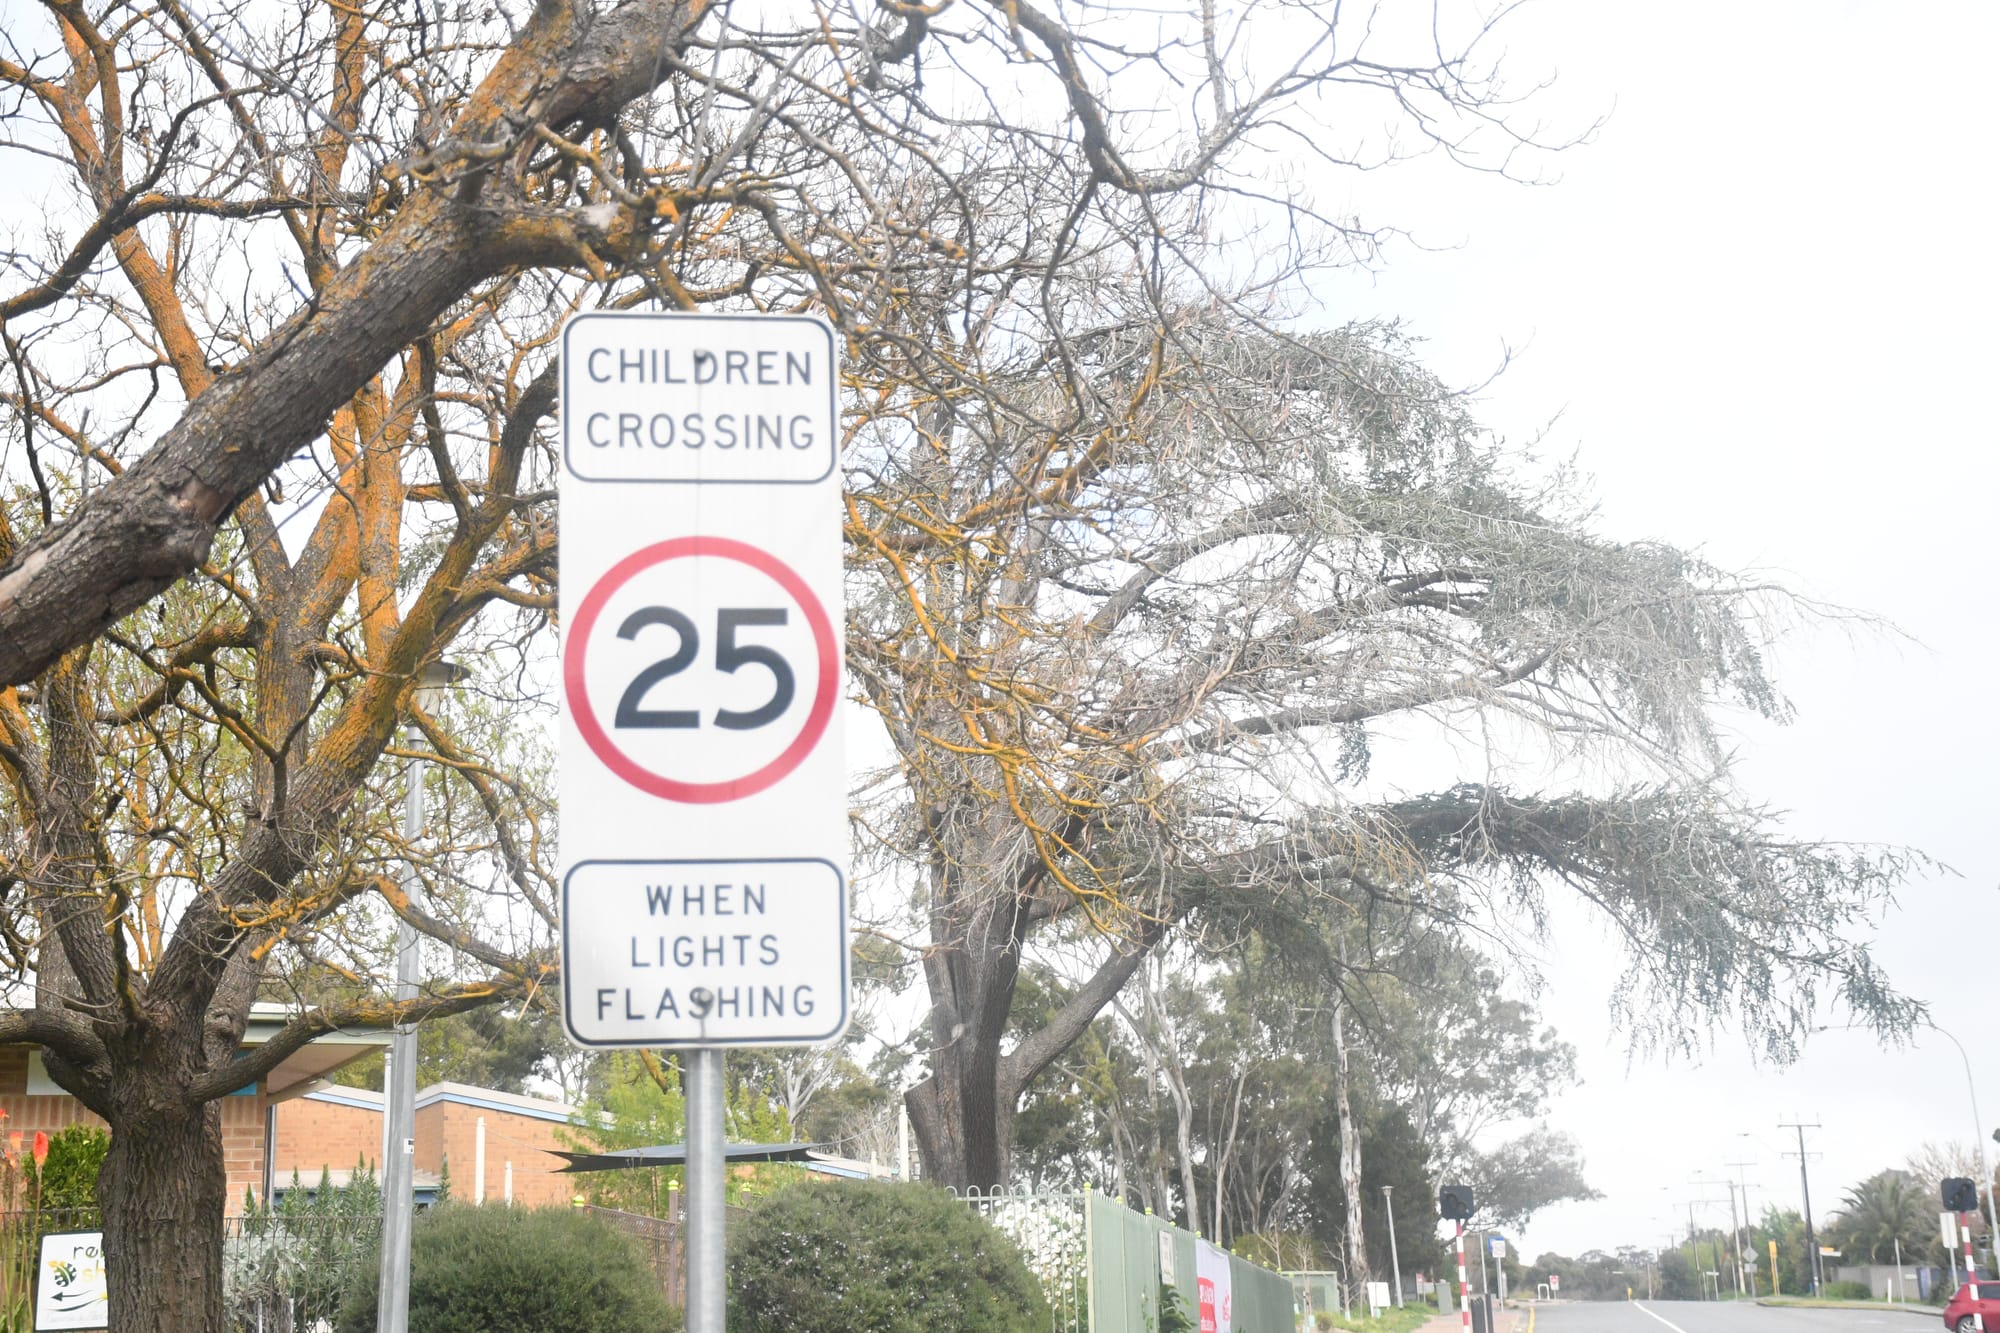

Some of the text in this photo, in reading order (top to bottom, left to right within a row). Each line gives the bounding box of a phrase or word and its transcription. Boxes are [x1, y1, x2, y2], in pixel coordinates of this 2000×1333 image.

[588, 347, 812, 385] CHILDREN
[587, 412, 814, 450] CROSSING
[614, 605, 796, 731] 25
[646, 884, 766, 916] WHEN
[631, 934, 780, 967] LIGHTS
[597, 985, 815, 1021] FLASHING
